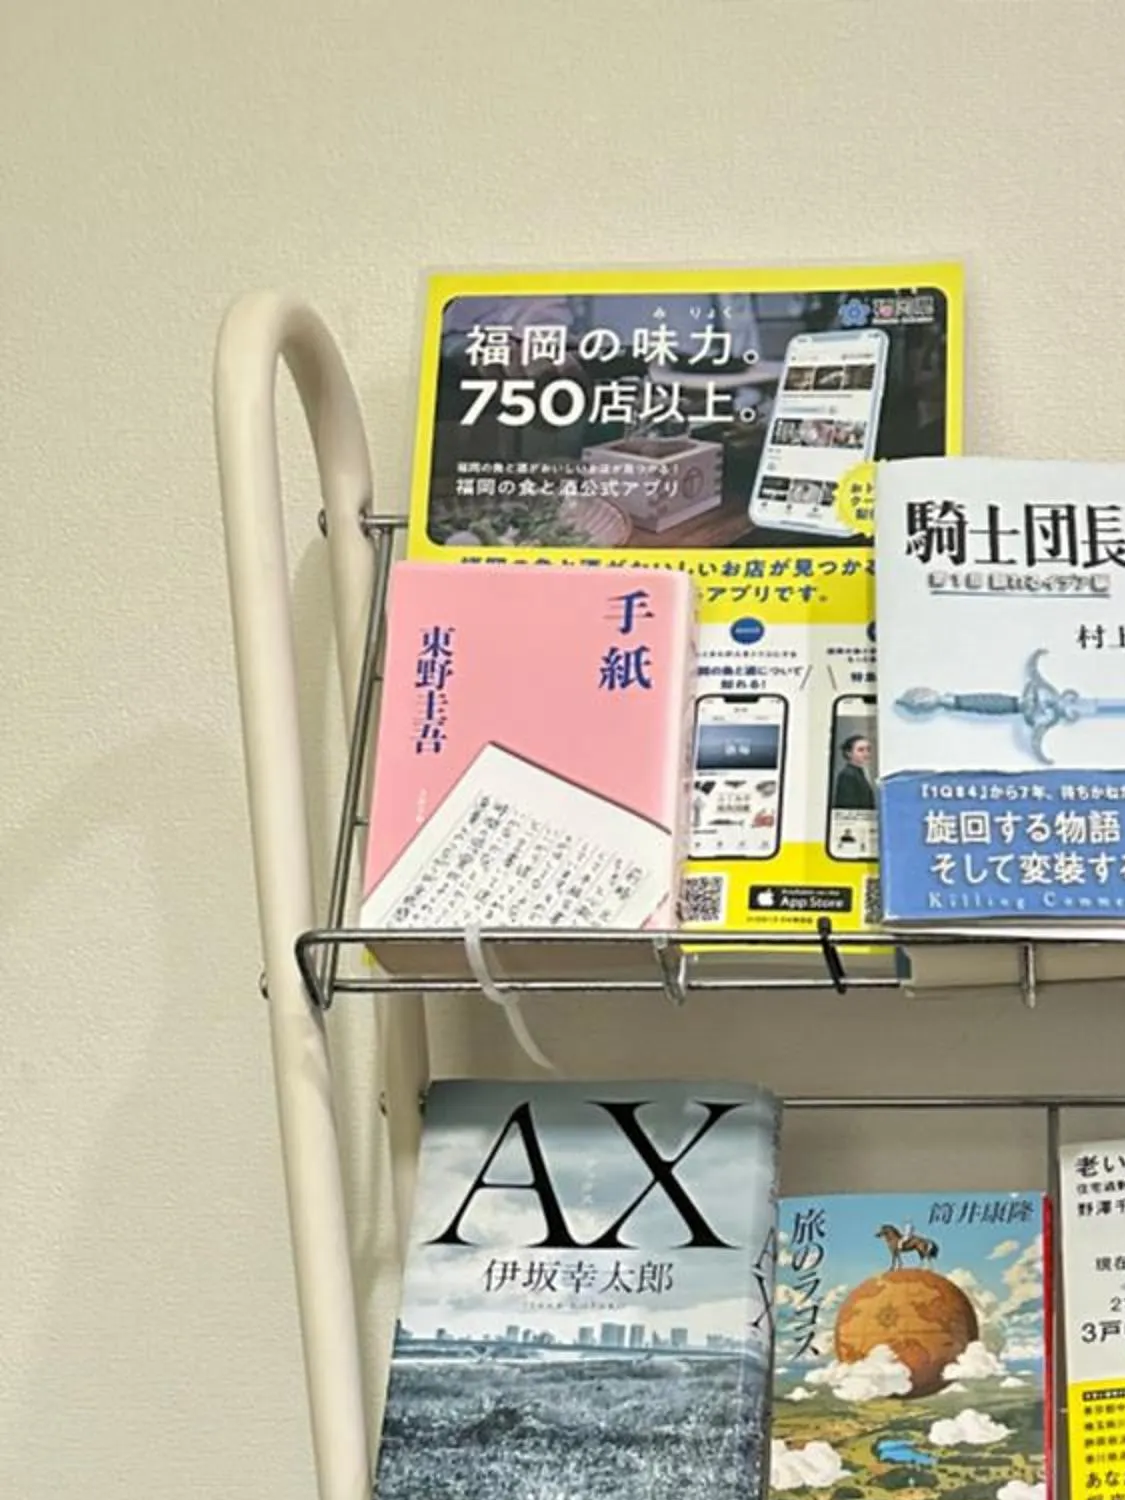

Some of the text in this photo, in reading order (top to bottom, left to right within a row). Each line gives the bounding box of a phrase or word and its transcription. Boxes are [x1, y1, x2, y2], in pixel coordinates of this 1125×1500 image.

[466, 324, 763, 367] 福岡の味力。
[458, 377, 763, 427] 750店以上。
[598, 589, 655, 691] 手紙
[414, 625, 456, 755] 東野圭吾
[925, 810, 1121, 844] 旋回する物語
[421, 1101, 749, 1250] AX
[928, 1201, 1036, 1225] 筒井康隆
[482, 1258, 674, 1296] 伊坂幸太郎
